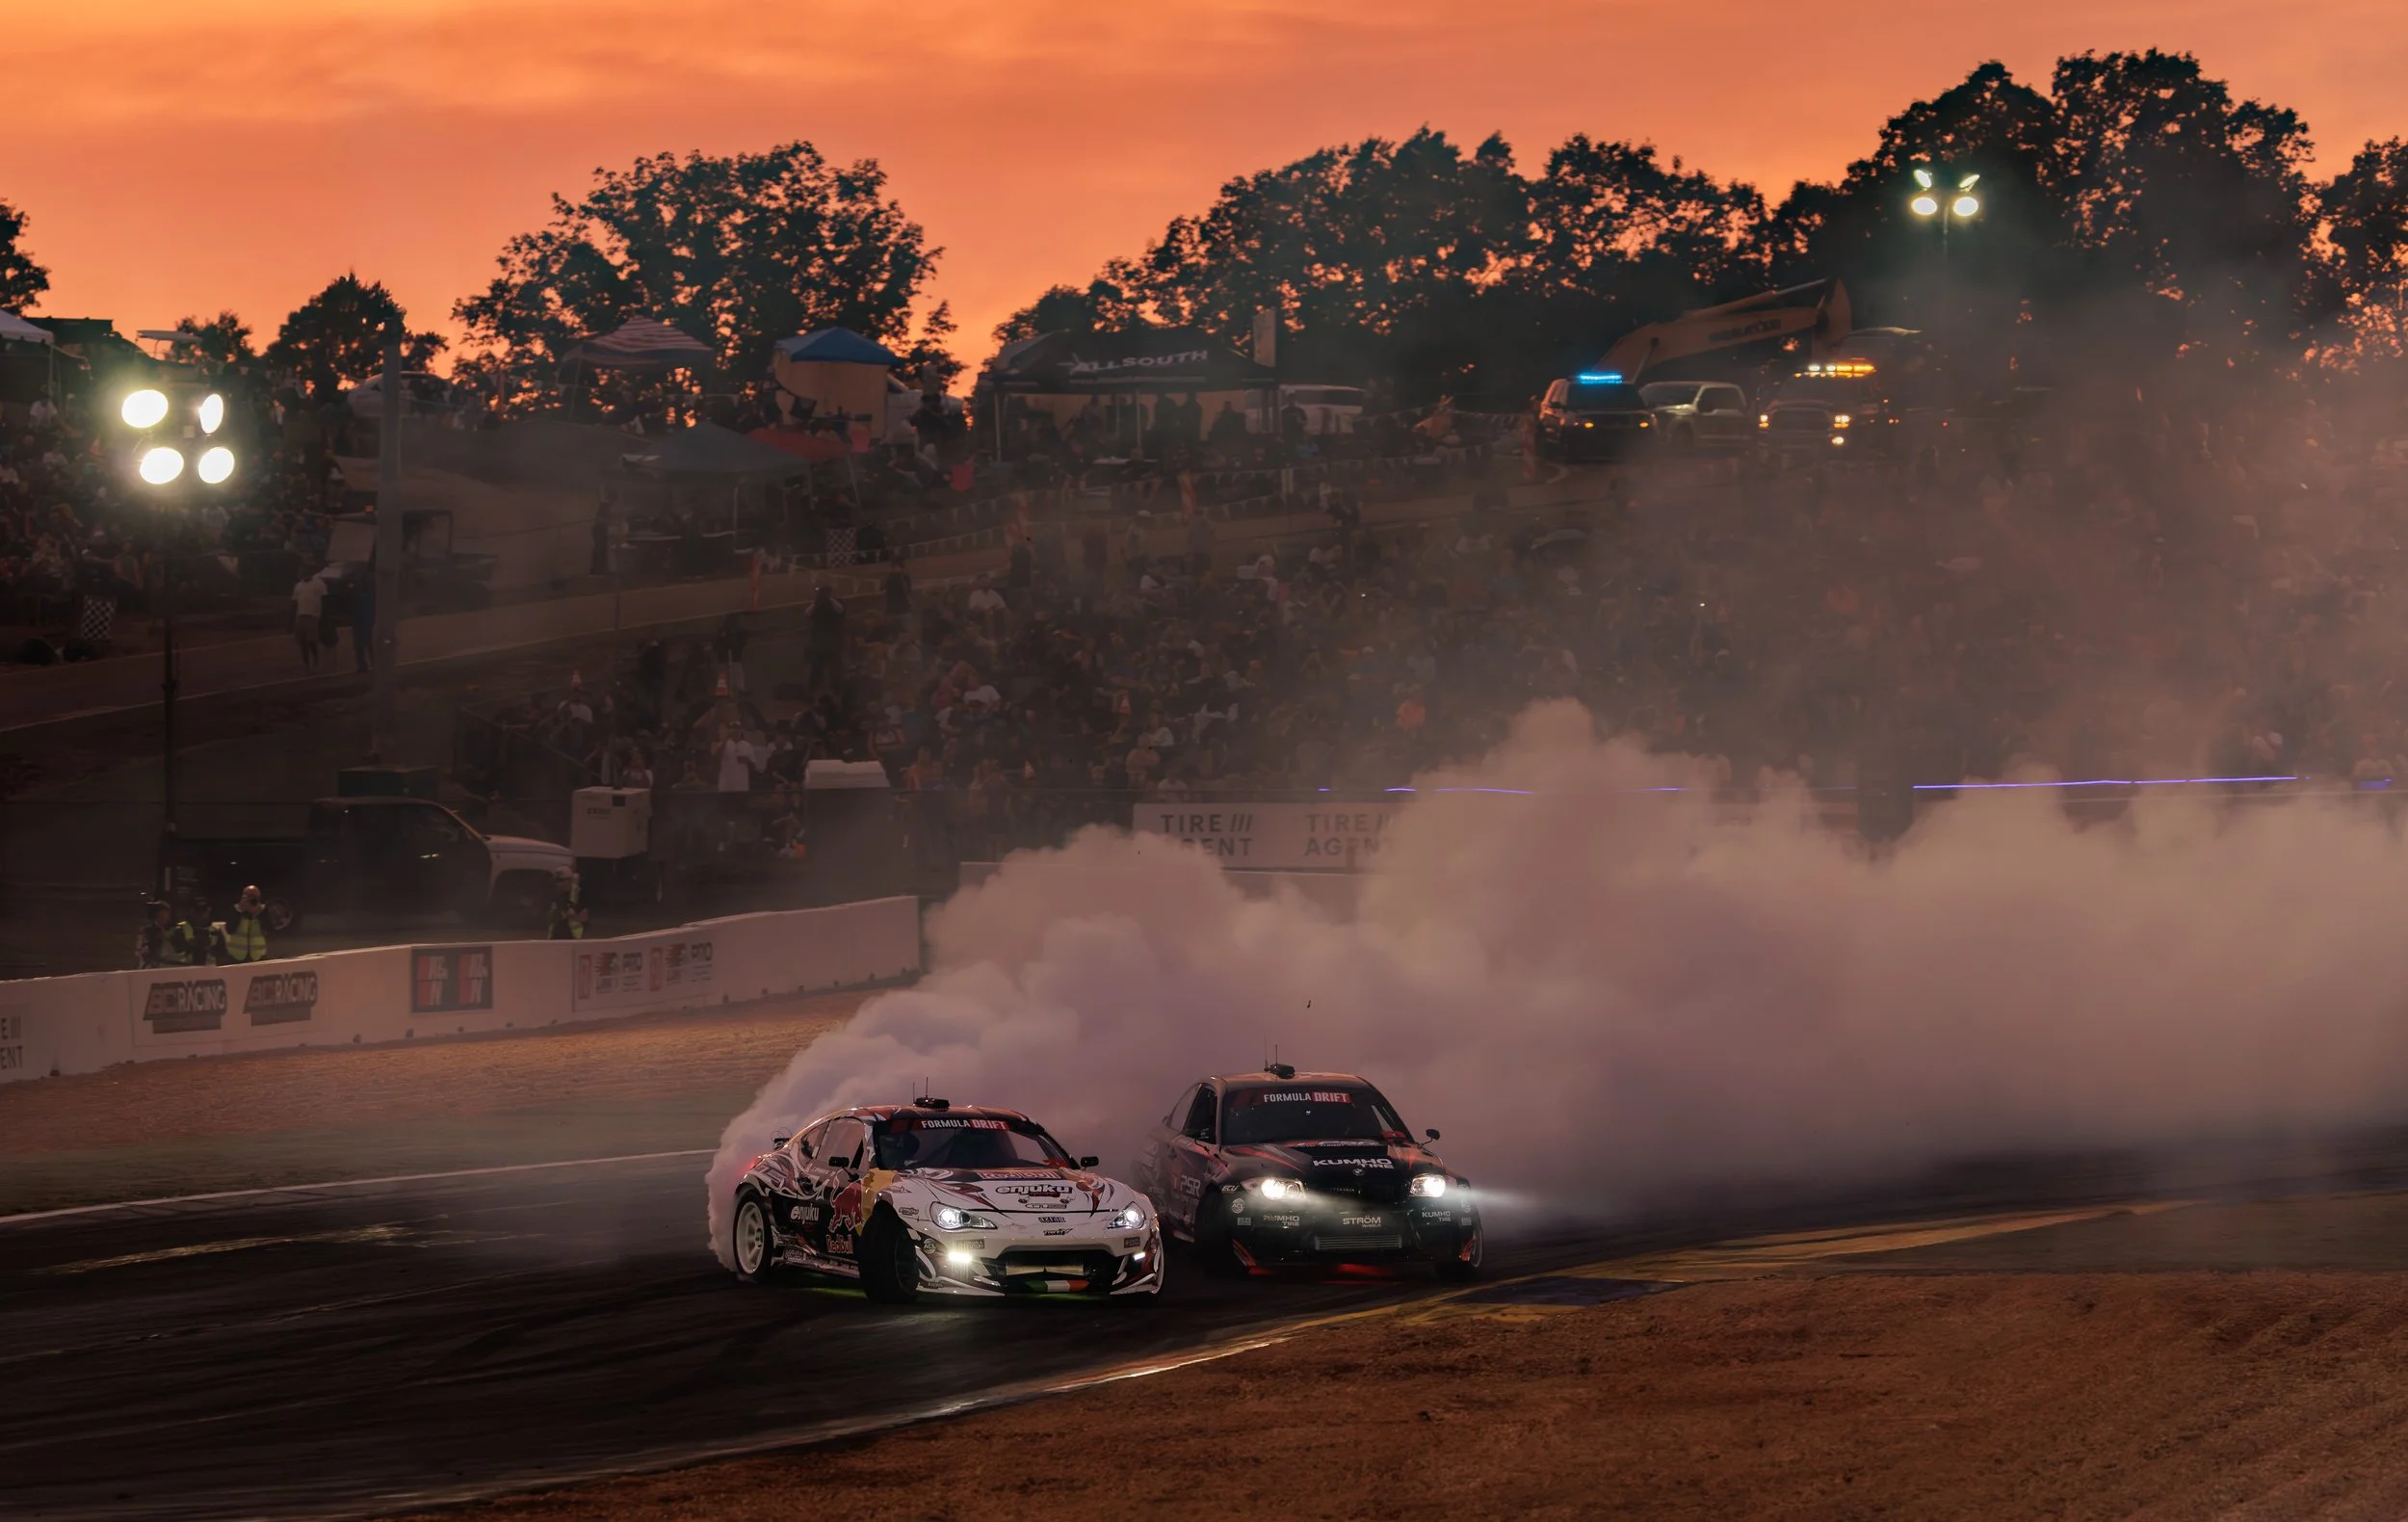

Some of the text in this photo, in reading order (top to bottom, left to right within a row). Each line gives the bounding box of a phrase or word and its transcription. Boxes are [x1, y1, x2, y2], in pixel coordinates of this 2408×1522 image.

[1069, 350, 1209, 374] ALLSOUTH
[1160, 814, 1222, 832] TIRE
[1306, 814, 1372, 832] TIRE
[178, 984, 226, 1012] RACING
[275, 976, 317, 1004] RACING
[0, 1045, 23, 1069] ENT
[1264, 1092, 1348, 1102] FORMULA DRIFT
[921, 1119, 1007, 1129] FORMULA DRIFT
[1313, 1158, 1393, 1168] KUMHO
[996, 1184, 1073, 1195] enjuku
[1180, 1174, 1201, 1197] PSR
[791, 1202, 820, 1224] enjuku
[1343, 1216, 1381, 1224] STRÖM
